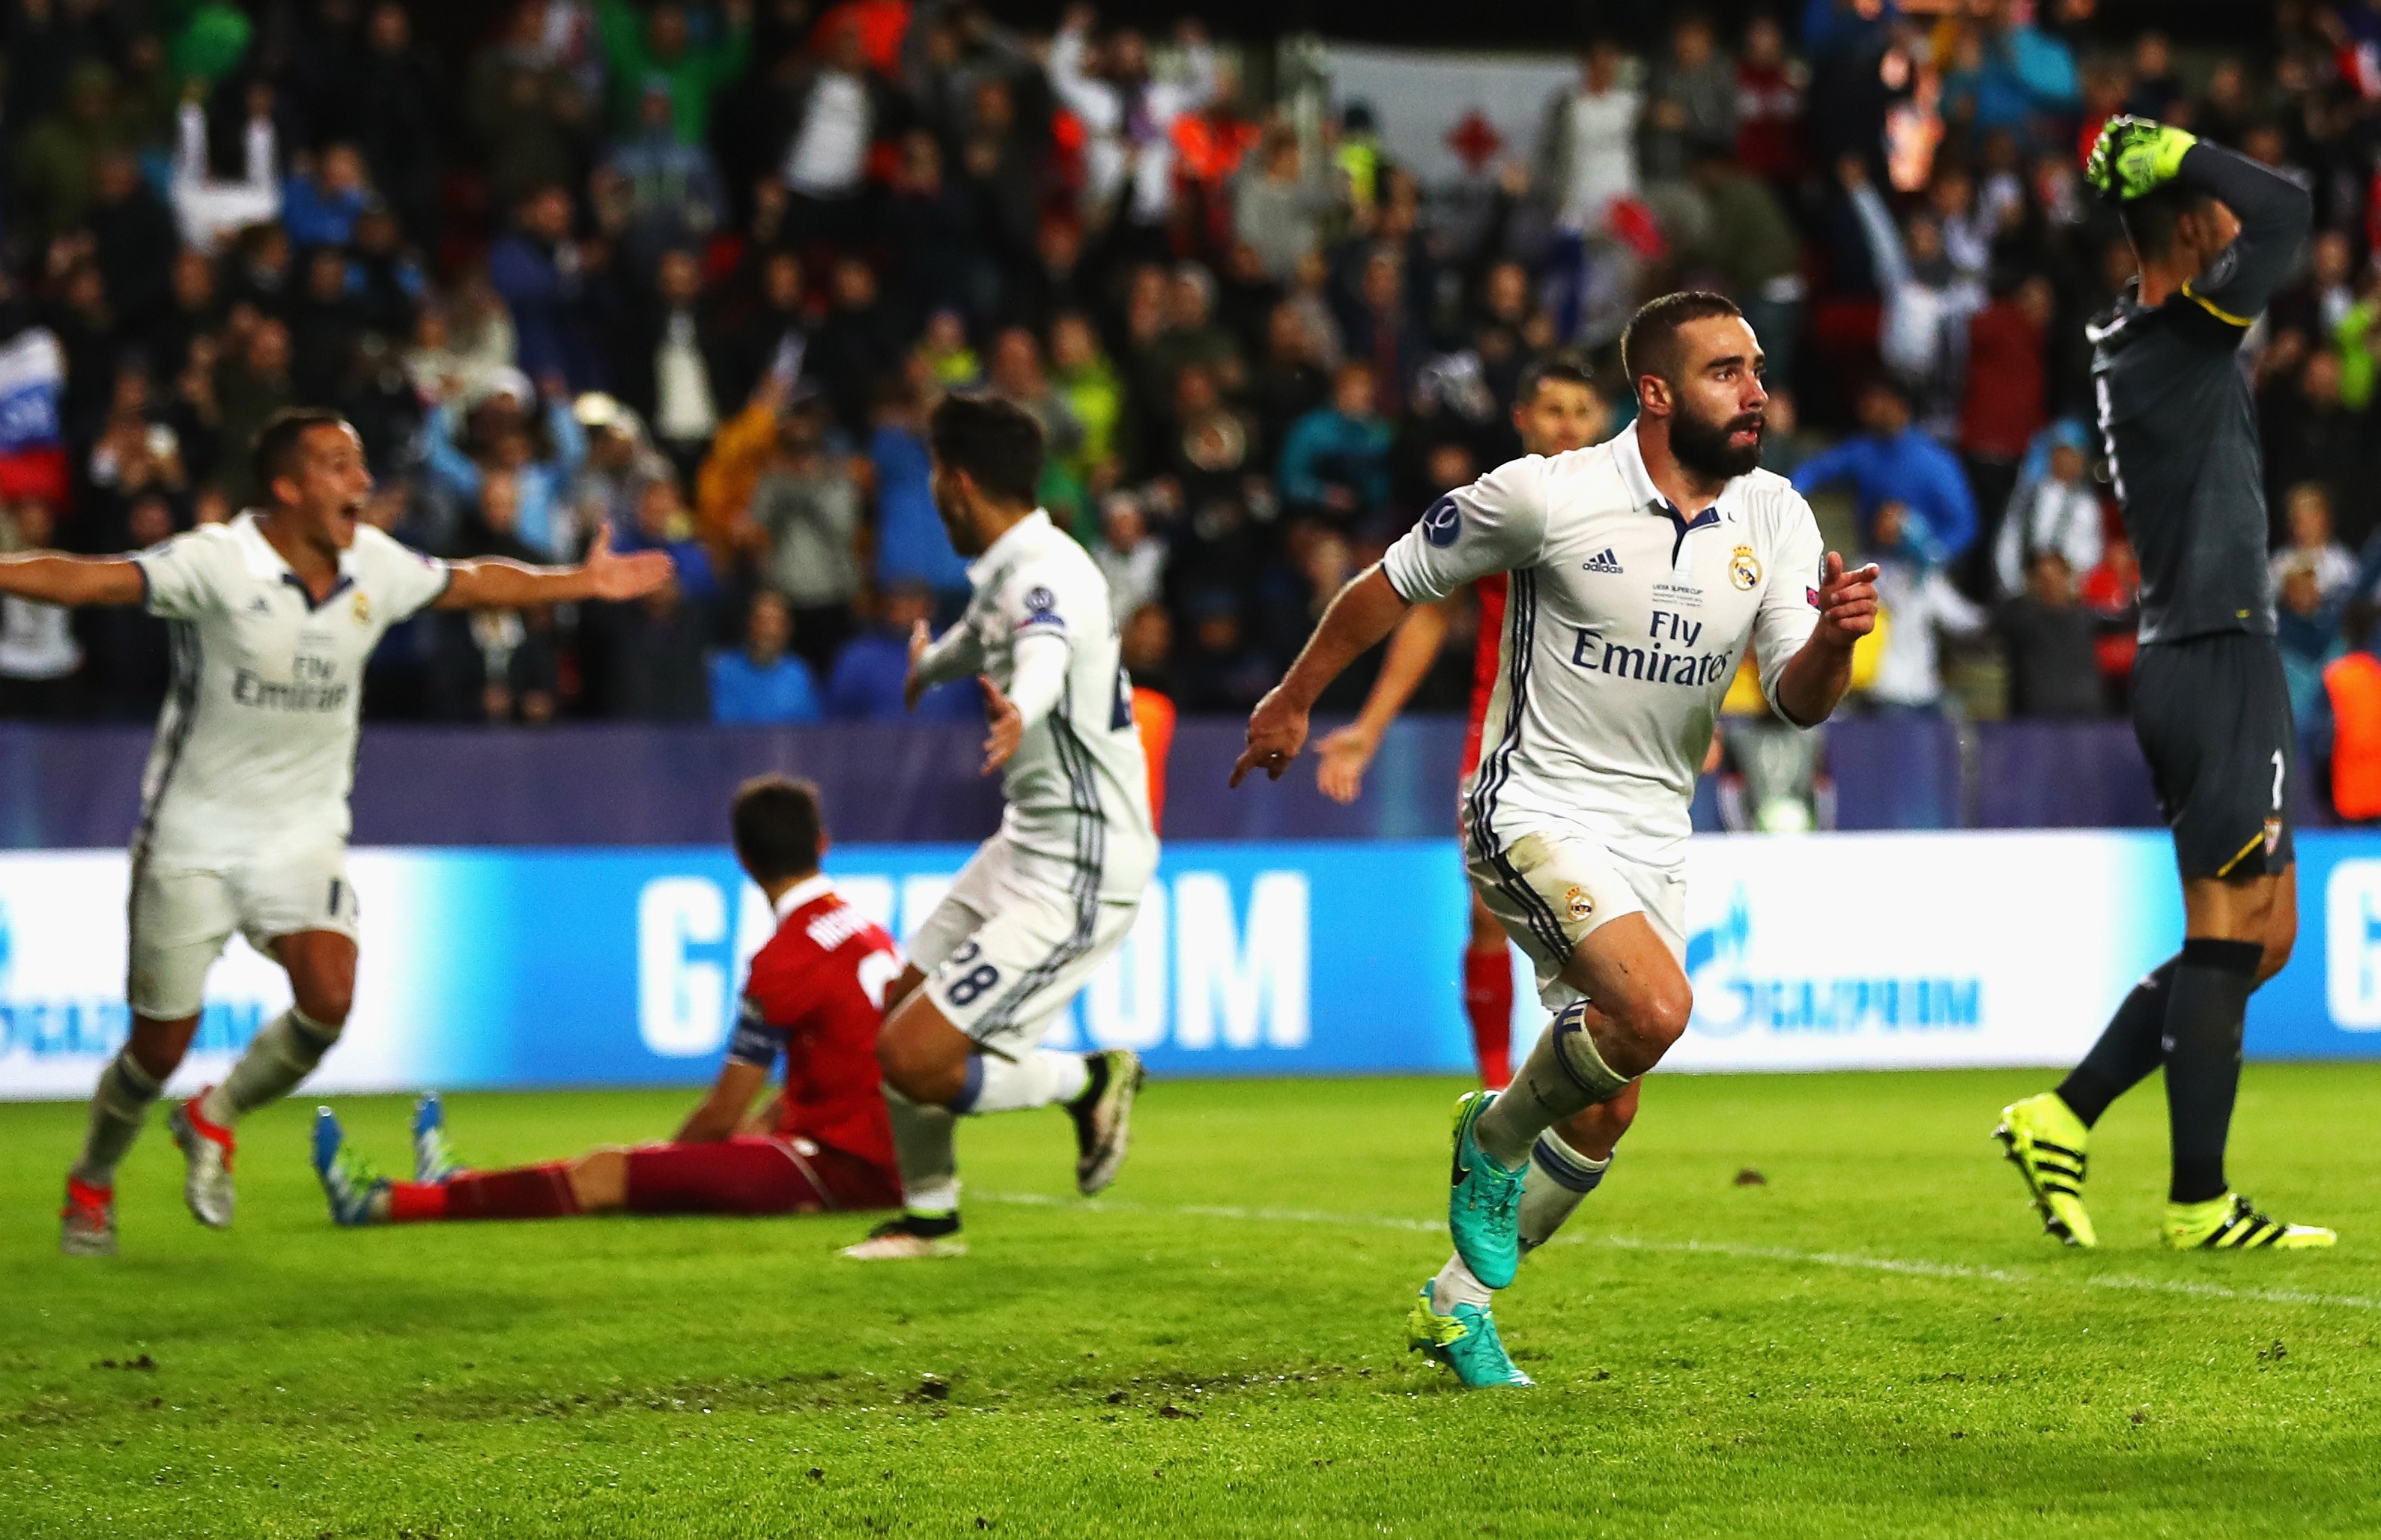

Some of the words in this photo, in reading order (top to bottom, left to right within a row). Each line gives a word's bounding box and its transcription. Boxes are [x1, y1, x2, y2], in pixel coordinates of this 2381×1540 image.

[1582, 562, 1624, 575] adidas
[1649, 610, 1702, 648] Fly
[1572, 628, 1733, 686] Emirates
[2270, 749, 2286, 810] 1
